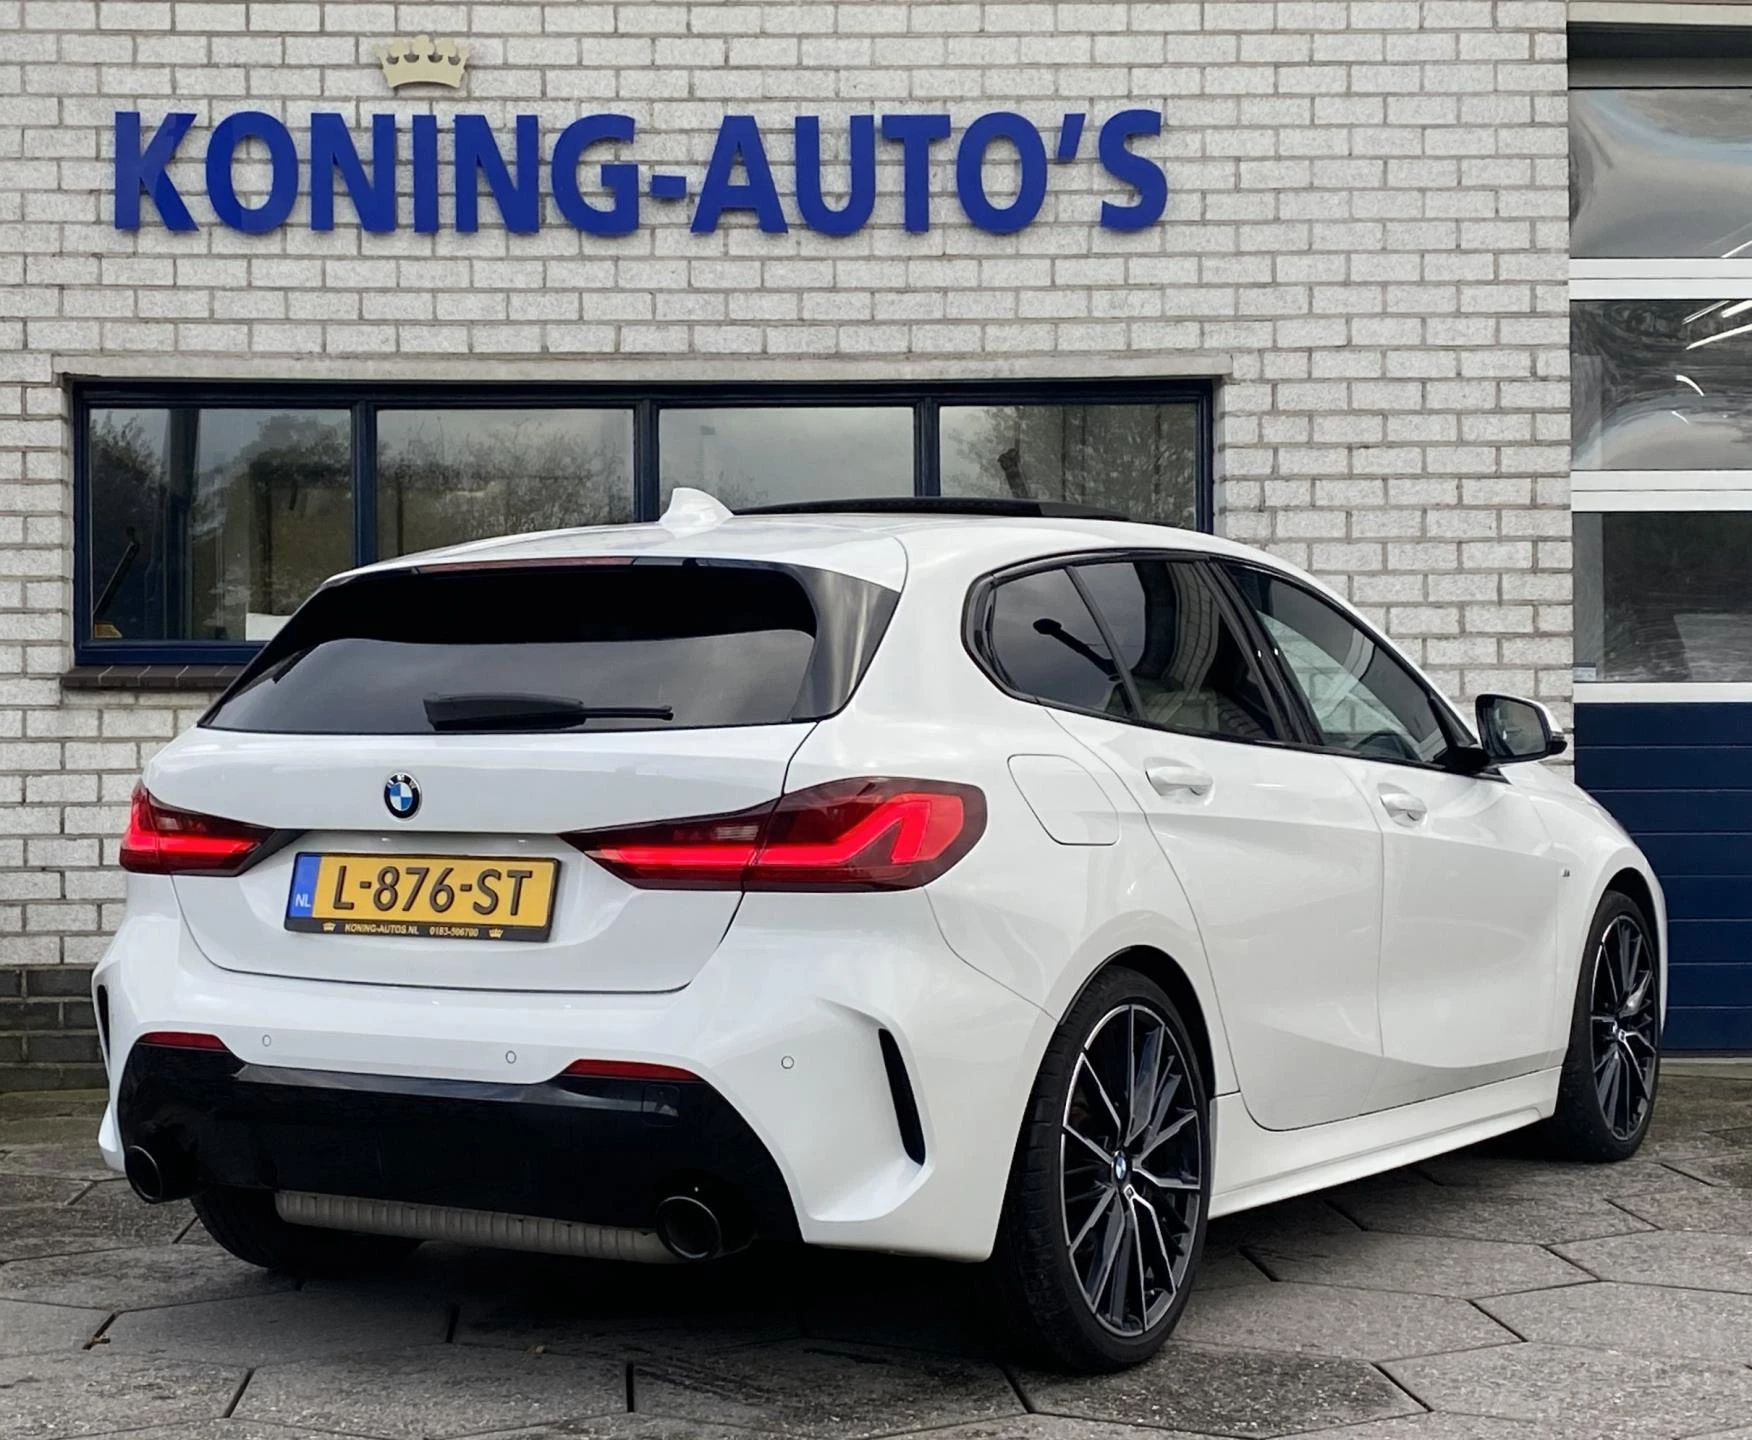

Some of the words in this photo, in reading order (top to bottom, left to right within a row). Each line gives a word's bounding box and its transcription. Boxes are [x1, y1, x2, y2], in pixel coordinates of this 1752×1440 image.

[114, 109, 1166, 234] KONING-AUTO'S
[295, 894, 311, 908] NL
[332, 865, 533, 917] L-876-ST
[344, 924, 420, 936] KONING-AUTOS.NL
